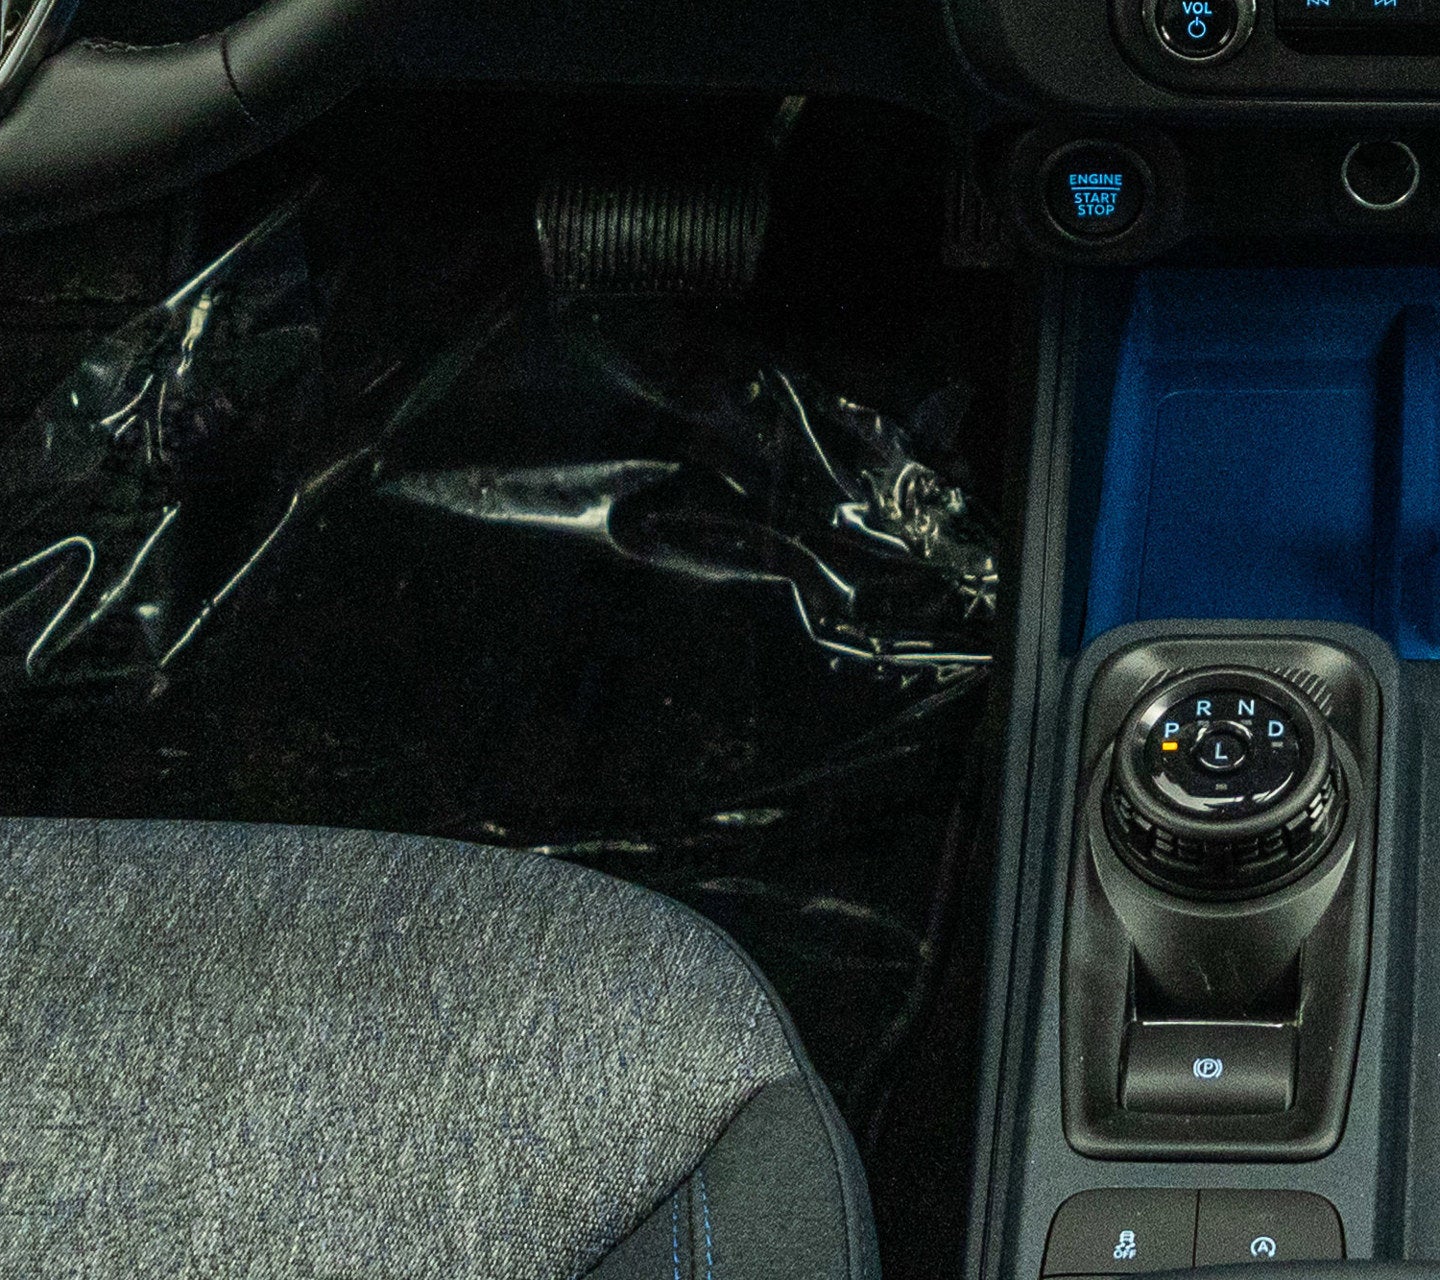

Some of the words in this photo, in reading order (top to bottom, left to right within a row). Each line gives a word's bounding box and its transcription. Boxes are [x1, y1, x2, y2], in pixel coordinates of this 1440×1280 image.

[1183, 2, 1212, 14] VOL
[1069, 174, 1122, 185] ENGINE
[1074, 193, 1117, 203] START
[1077, 204, 1114, 216] STOP
[1197, 701, 1211, 716] R
[1238, 700, 1255, 715] N
[1165, 723, 1179, 738] P
[1268, 721, 1284, 736] D
[1215, 742, 1228, 759] L
[1113, 1249, 1136, 1259] OFF
